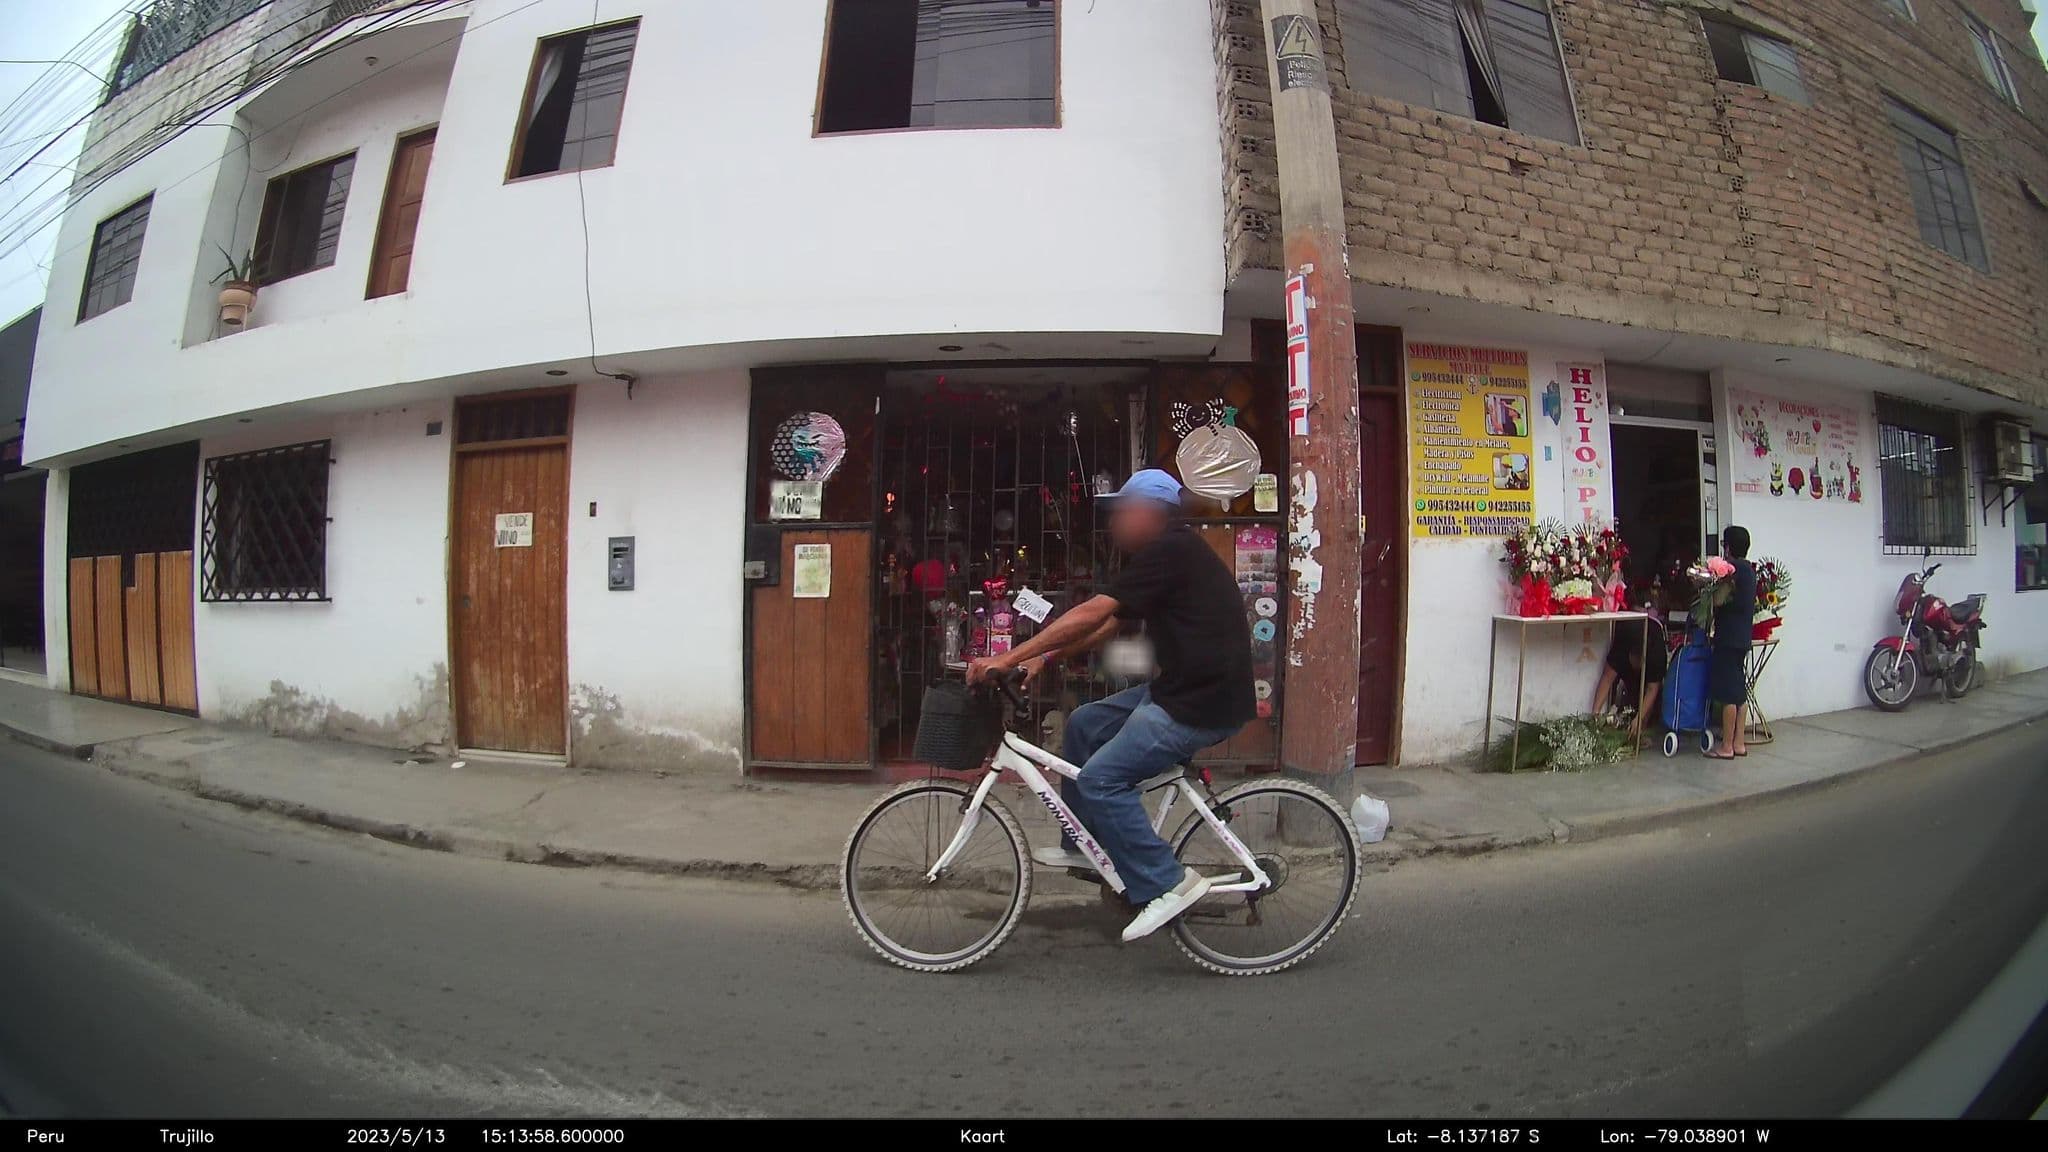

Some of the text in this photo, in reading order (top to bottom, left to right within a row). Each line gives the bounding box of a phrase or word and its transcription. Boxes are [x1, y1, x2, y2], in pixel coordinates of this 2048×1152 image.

[1408, 343, 1466, 360] SERVICIOS
[1569, 367, 1597, 463] HELIO
[1423, 435, 1473, 448] Mantenimiento
[1423, 447, 1450, 459] Madera
[1456, 448, 1475, 460] Pisos
[1423, 460, 1462, 472] Enchapado
[1423, 473, 1452, 484] Drywall
[1458, 473, 1490, 484] Melamine
[1423, 485, 1489, 497] Pintura en General
[1427, 499, 1531, 513] 995432444 942255155
[1416, 515, 1456, 526] GARANTÍA
[1463, 515, 1530, 526] RESPONSABILIDAD
[1428, 525, 1462, 536] CALIDAD
[1037, 790, 1084, 844] MONARK
